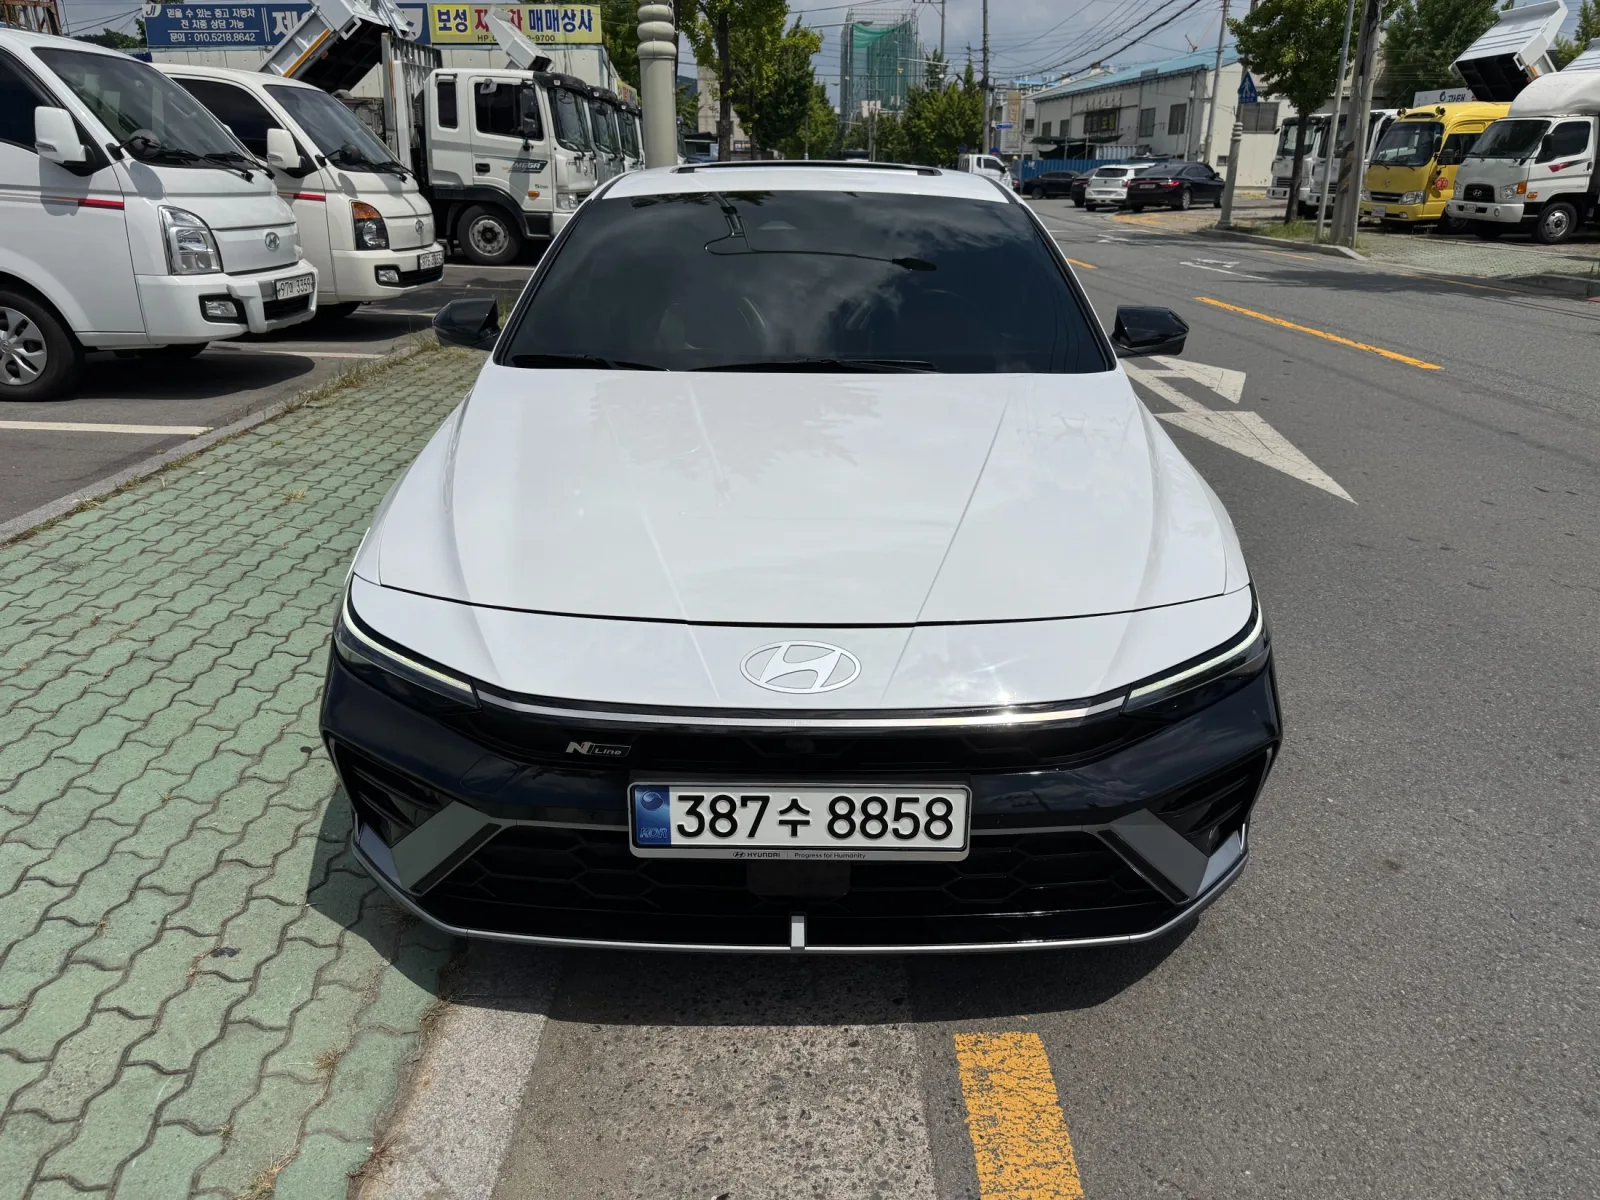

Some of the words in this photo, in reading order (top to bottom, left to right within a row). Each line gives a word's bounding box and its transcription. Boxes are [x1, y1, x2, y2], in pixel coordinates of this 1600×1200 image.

[166, 8, 183, 18] 믿을
[185, 8, 194, 18] 수
[196, 8, 212, 18] 있는
[214, 8, 230, 18] 중고
[232, 8, 256, 18] 자동차
[180, 19, 190, 29] 전
[210, 19, 226, 29] 상담
[229, 19, 245, 29] 가능
[436, 8, 469, 33] 보성
[474, 9, 523, 33] 자차
[528, 9, 593, 33] 매매상사
[170, 33, 186, 42] 문의
[194, 33, 256, 42] 010.5218.8642
[594, 747, 622, 756] Line
[676, 794, 811, 839] 387수
[826, 795, 955, 841] 8858
[639, 827, 668, 839] KOR
[794, 852, 822, 860] Progress
